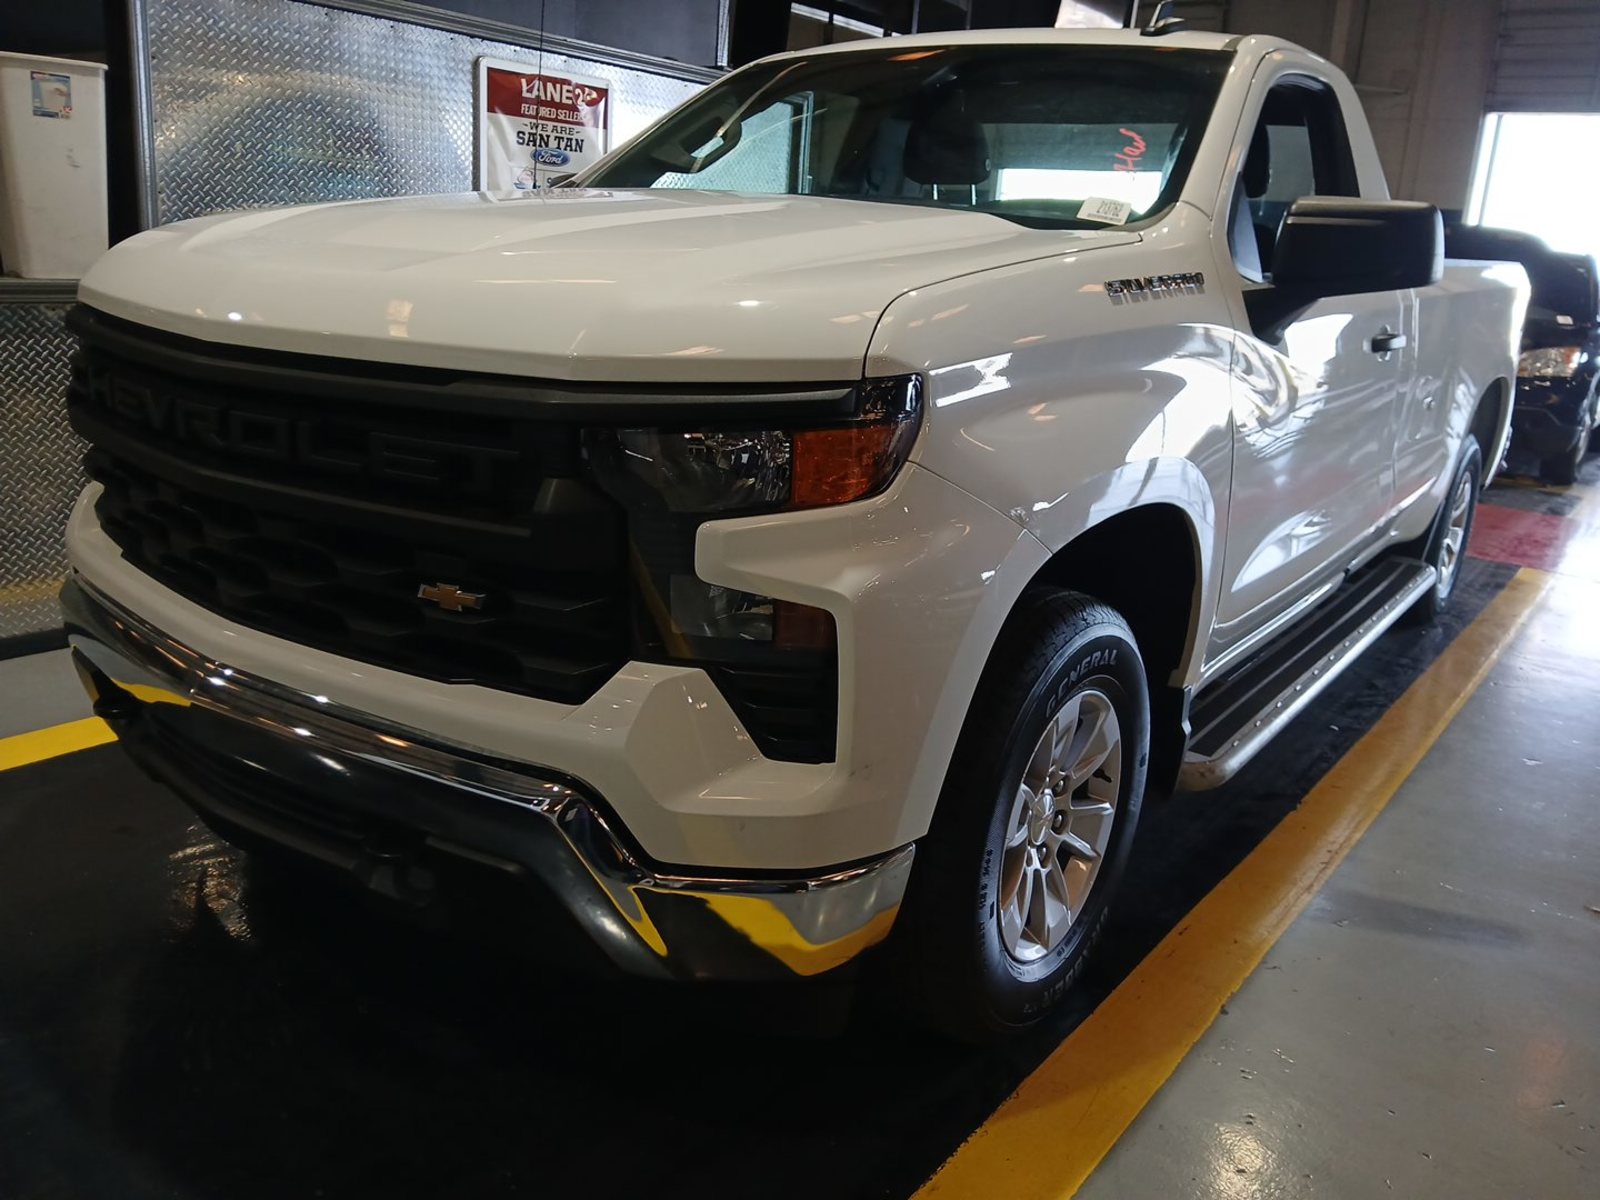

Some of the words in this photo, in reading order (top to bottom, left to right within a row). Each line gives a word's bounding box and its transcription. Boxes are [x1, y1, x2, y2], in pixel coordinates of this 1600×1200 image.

[521, 78, 573, 105] LANE
[516, 130, 551, 148] SAN
[554, 136, 584, 153] TAN
[538, 151, 564, 164] Ford
[1104, 272, 1204, 297] SILVERADO
[1045, 648, 1118, 718] GENERAL
